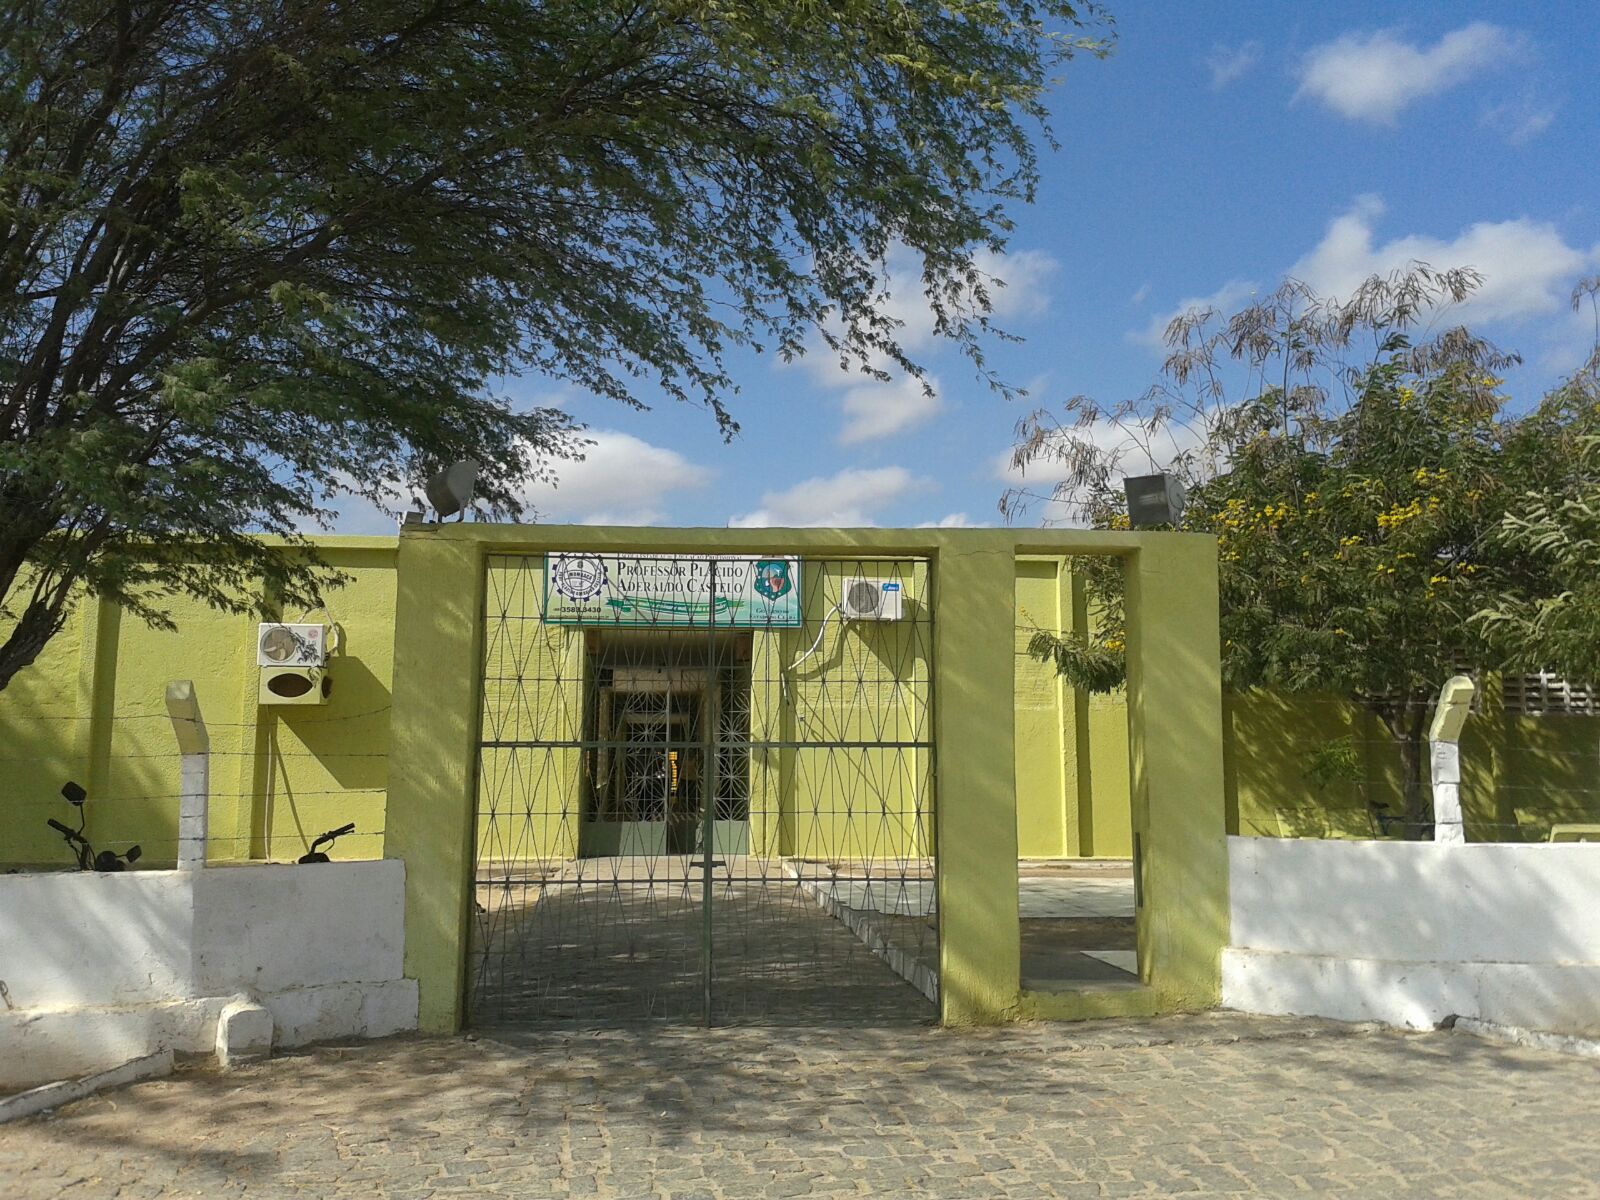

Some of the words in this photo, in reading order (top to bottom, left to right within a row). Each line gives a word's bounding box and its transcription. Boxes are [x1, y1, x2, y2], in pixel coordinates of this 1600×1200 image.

[617, 561, 686, 577] PROFESSOR
[617, 578, 684, 593] ADERALDO
[687, 578, 743, 594] CASTELO
